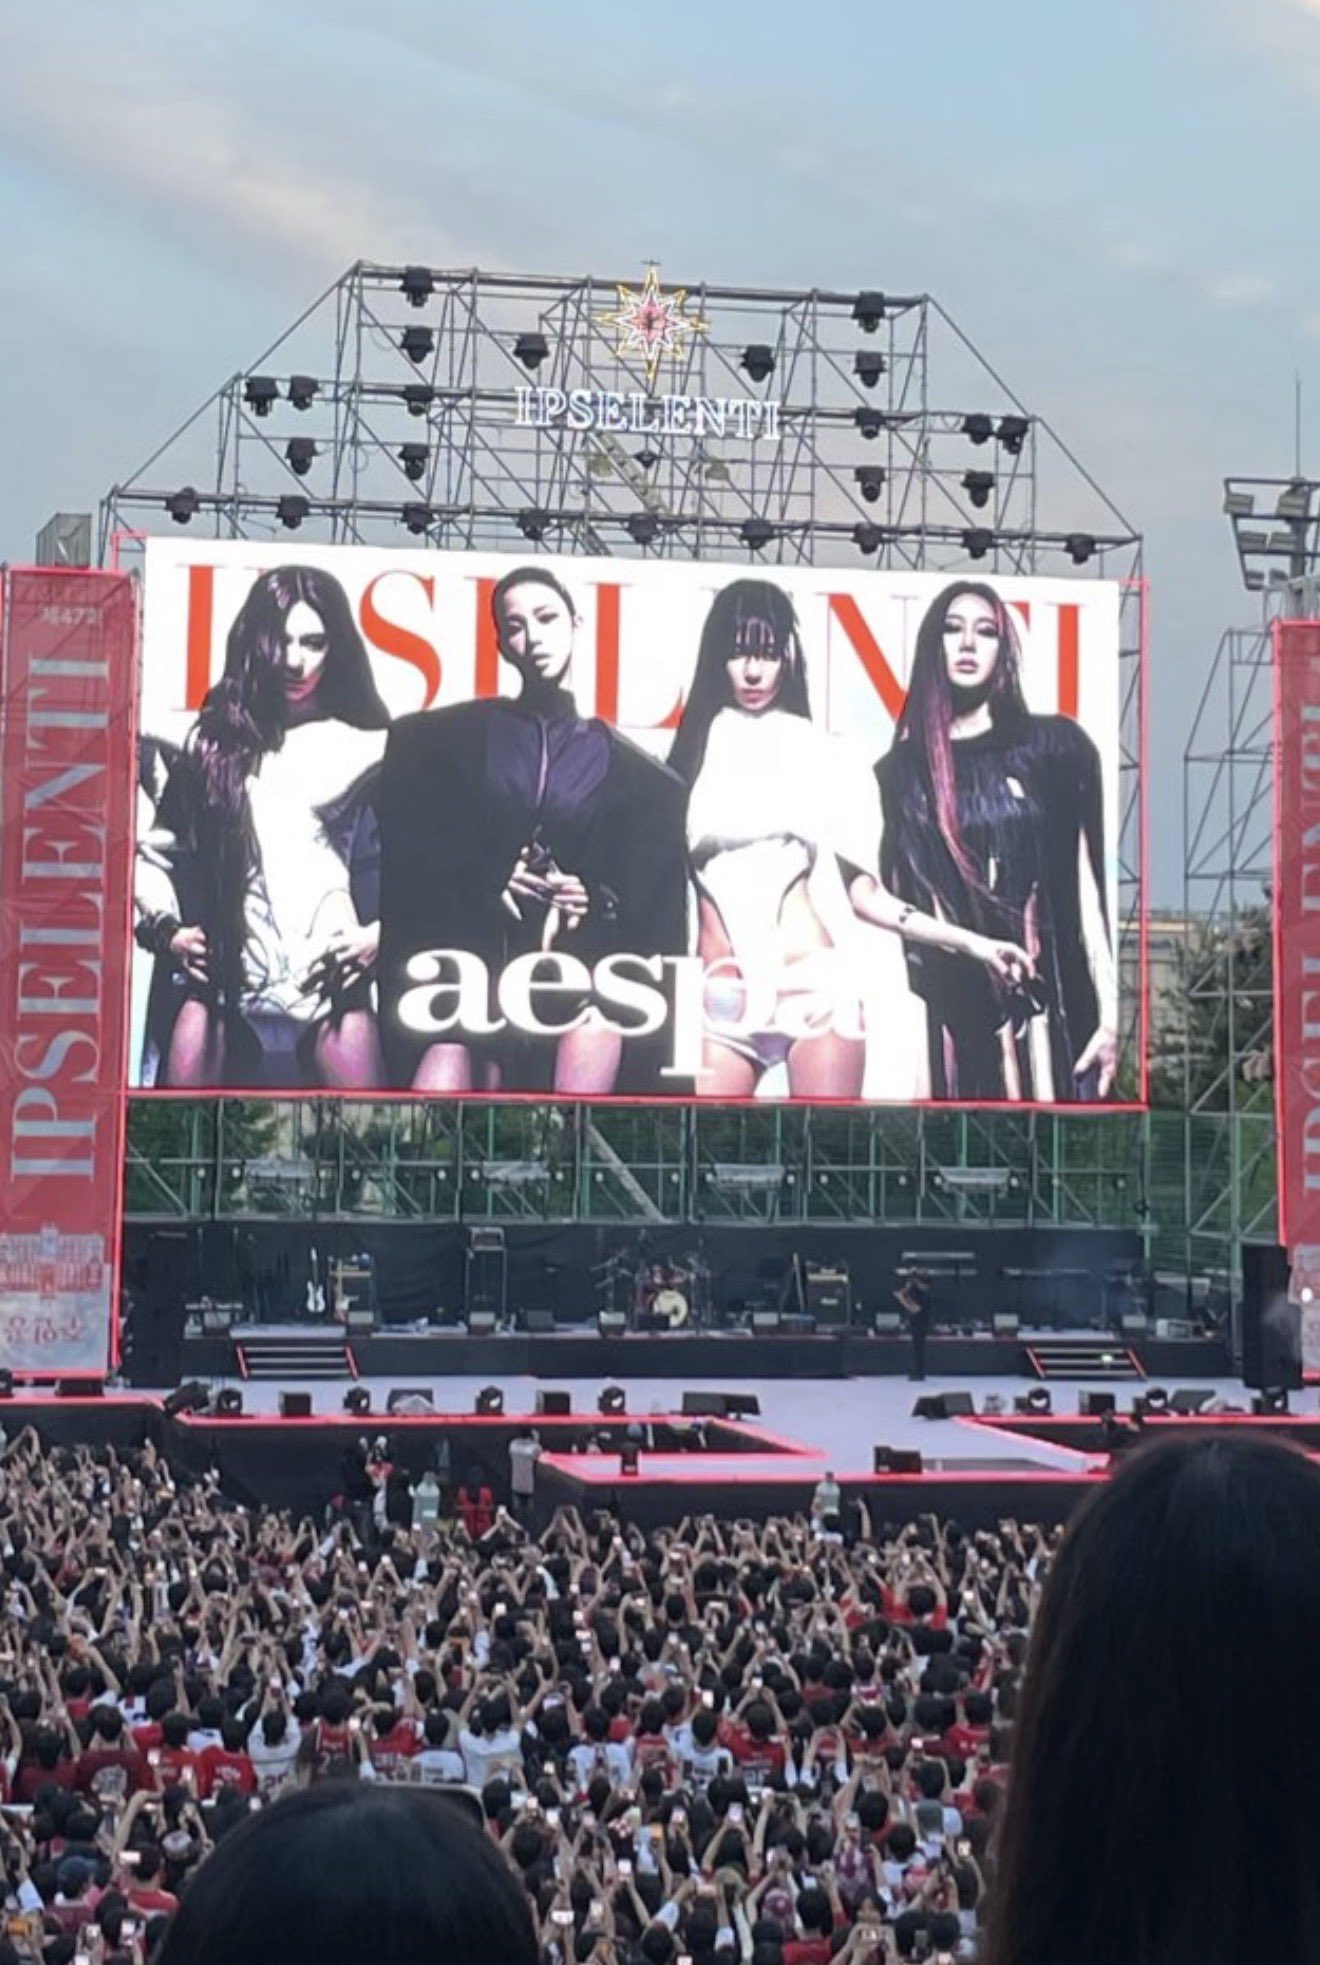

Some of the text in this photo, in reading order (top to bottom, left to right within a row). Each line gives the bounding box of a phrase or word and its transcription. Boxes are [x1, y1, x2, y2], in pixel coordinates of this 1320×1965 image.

[515, 386, 781, 440] IPSELENTI
[11, 658, 110, 1182] IPSELENTI
[397, 947, 866, 1080] aespa
